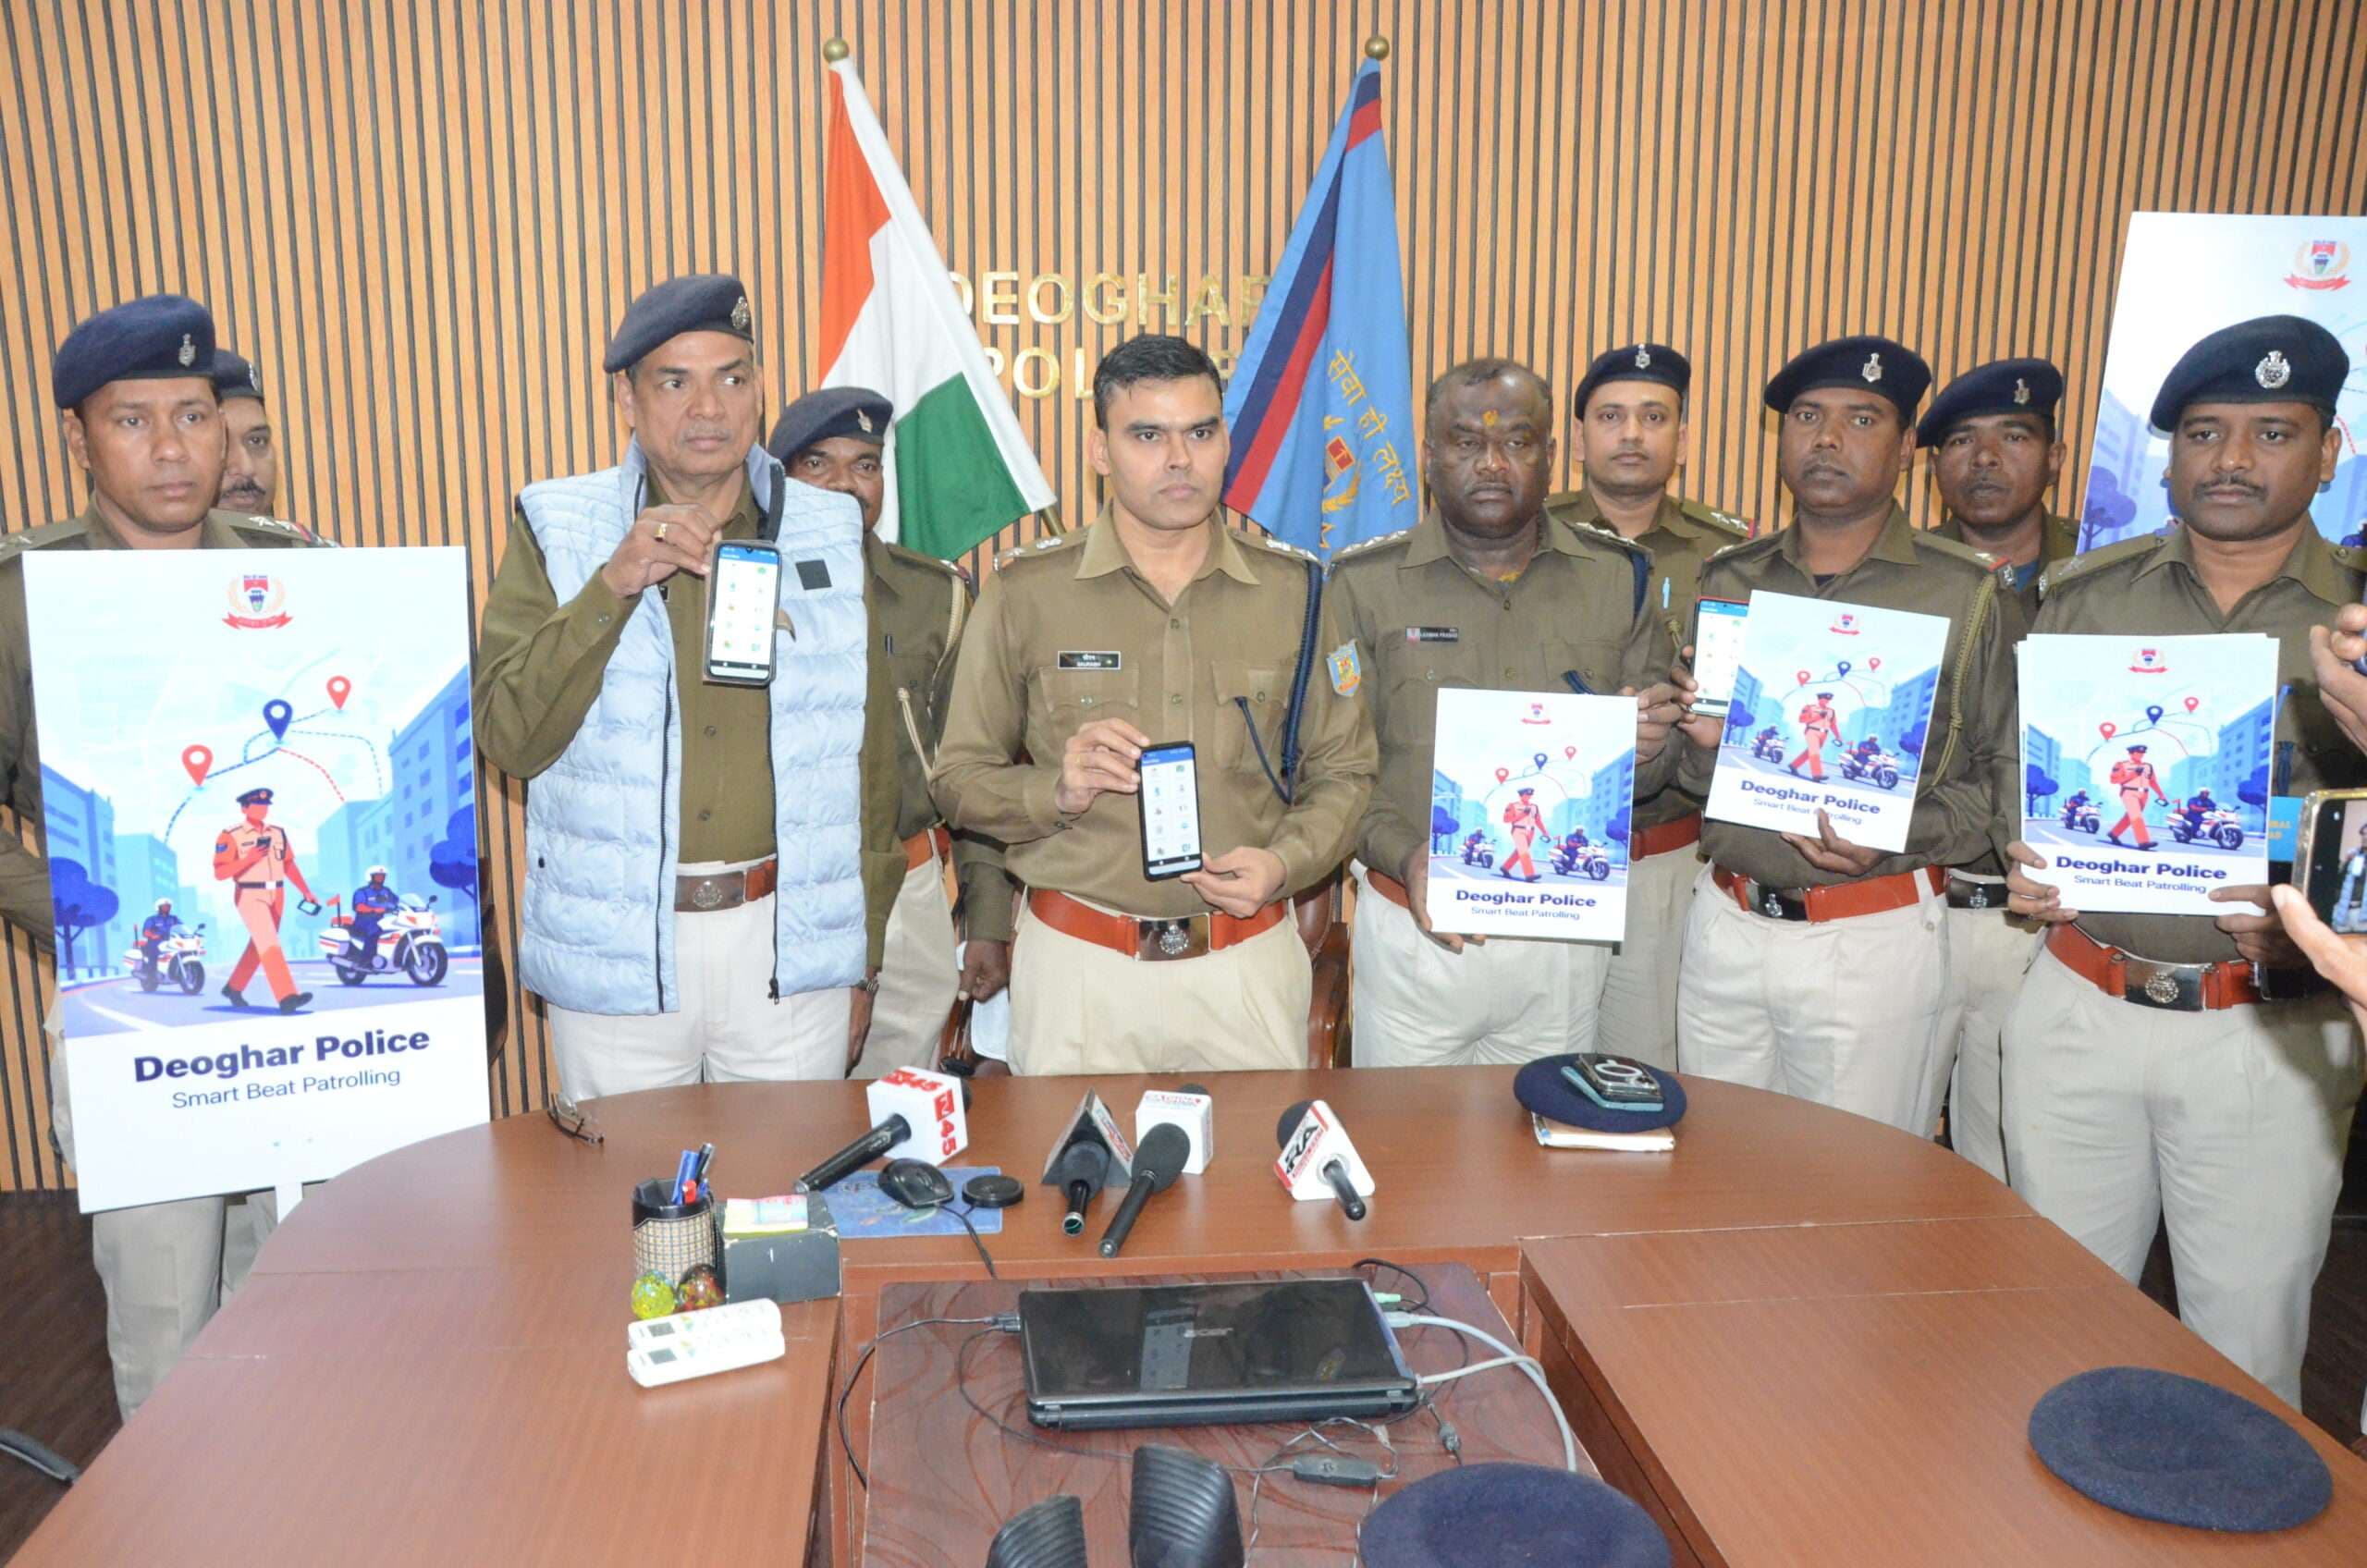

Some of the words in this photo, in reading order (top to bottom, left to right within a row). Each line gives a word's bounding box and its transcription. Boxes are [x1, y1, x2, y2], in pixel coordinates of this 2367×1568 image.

[1358, 404, 1388, 440] ही
[1740, 780, 1819, 802] Deoghar
[1823, 795, 1881, 814] Police
[1753, 799, 1784, 810] Smart
[1786, 804, 1810, 815] Beat
[1813, 808, 1862, 825] rolling
[2056, 856, 2151, 874] Deoghar
[2156, 864, 2227, 878] Police
[2074, 875, 2111, 886] Smart
[2115, 878, 2143, 888] Beat
[2147, 880, 2207, 894] Patrolling
[1456, 889, 1535, 905] Deoghar
[1539, 894, 1597, 907] Police
[1471, 907, 1502, 915] Smart
[1504, 908, 1528, 917] Beat
[1531, 910, 1580, 920] Patrolling
[134, 1045, 304, 1083] Deoghar
[315, 1029, 430, 1060] Police
[172, 1086, 239, 1109] Smart
[247, 1081, 296, 1098] Beat
[303, 1070, 400, 1094] Patrolling
